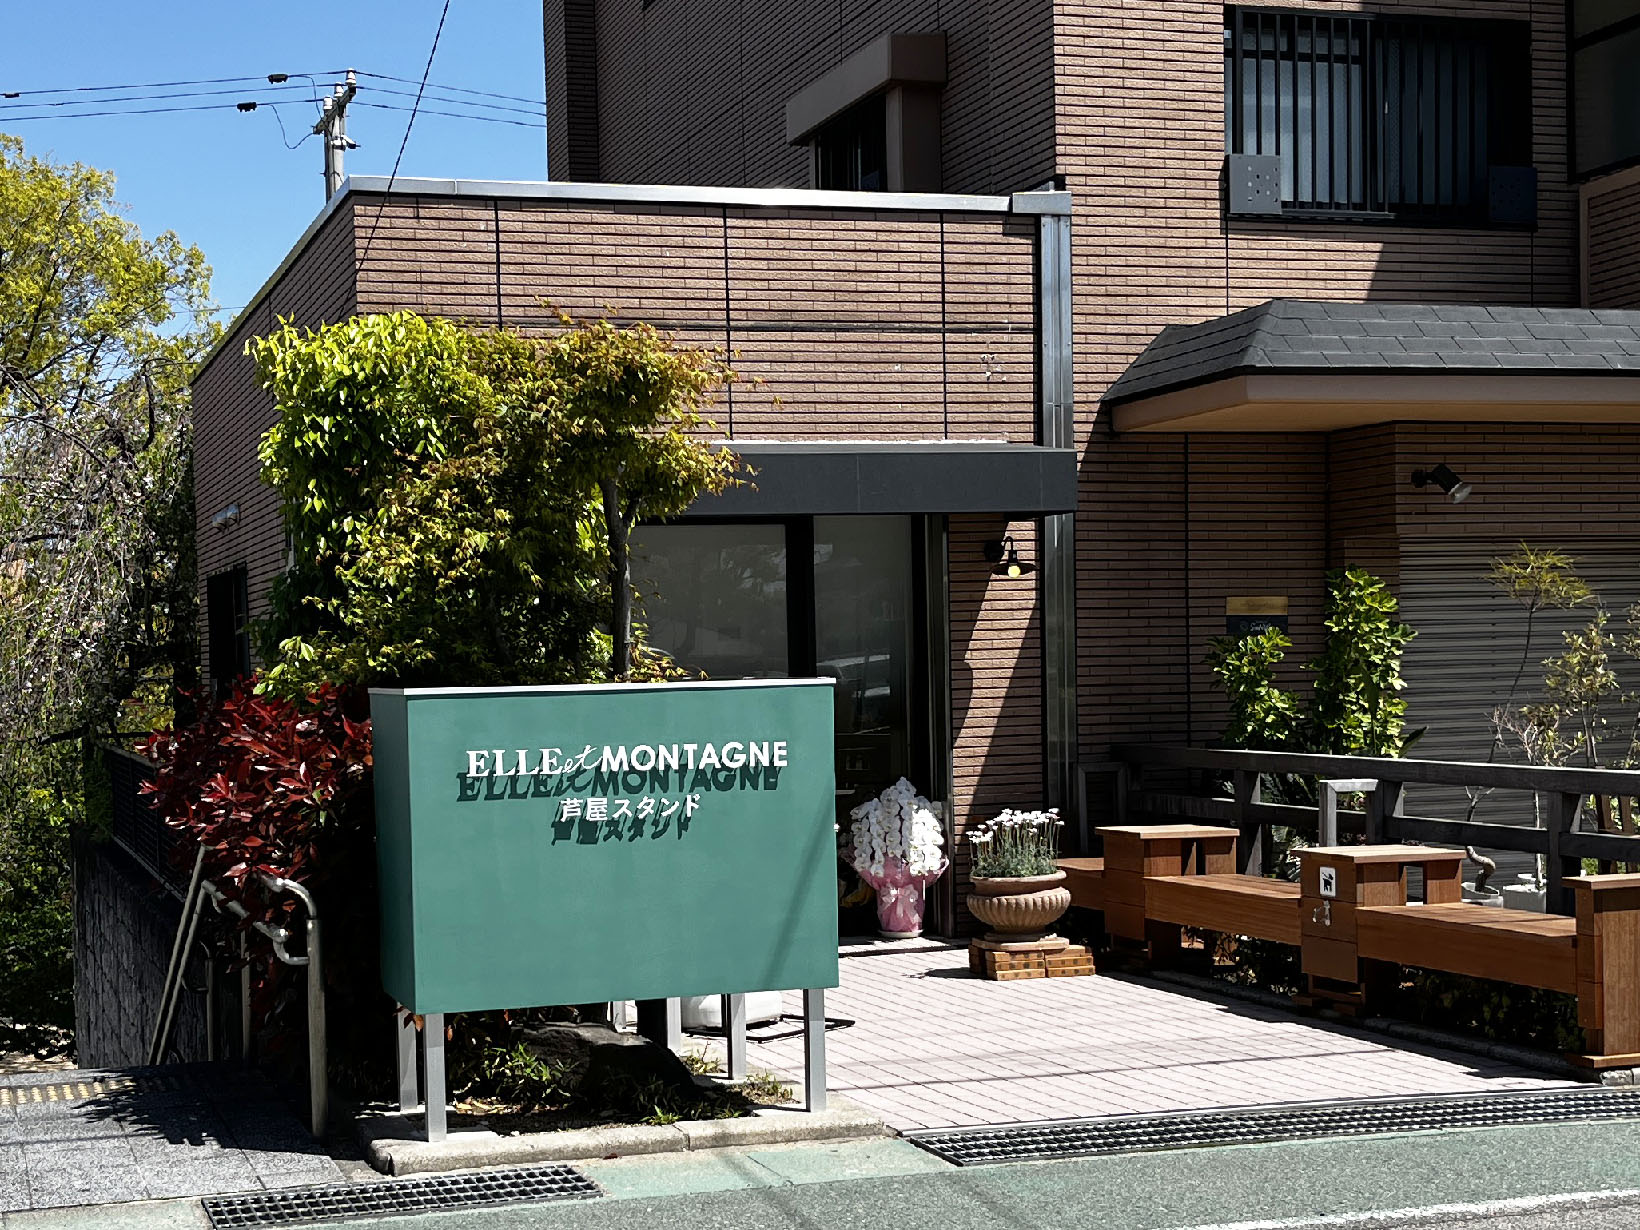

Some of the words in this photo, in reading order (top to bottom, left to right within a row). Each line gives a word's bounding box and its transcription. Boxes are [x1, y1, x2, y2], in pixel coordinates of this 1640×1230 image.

[602, 741, 788, 772] MONTAGNE
[560, 793, 701, 823] 芦屋スタンド
